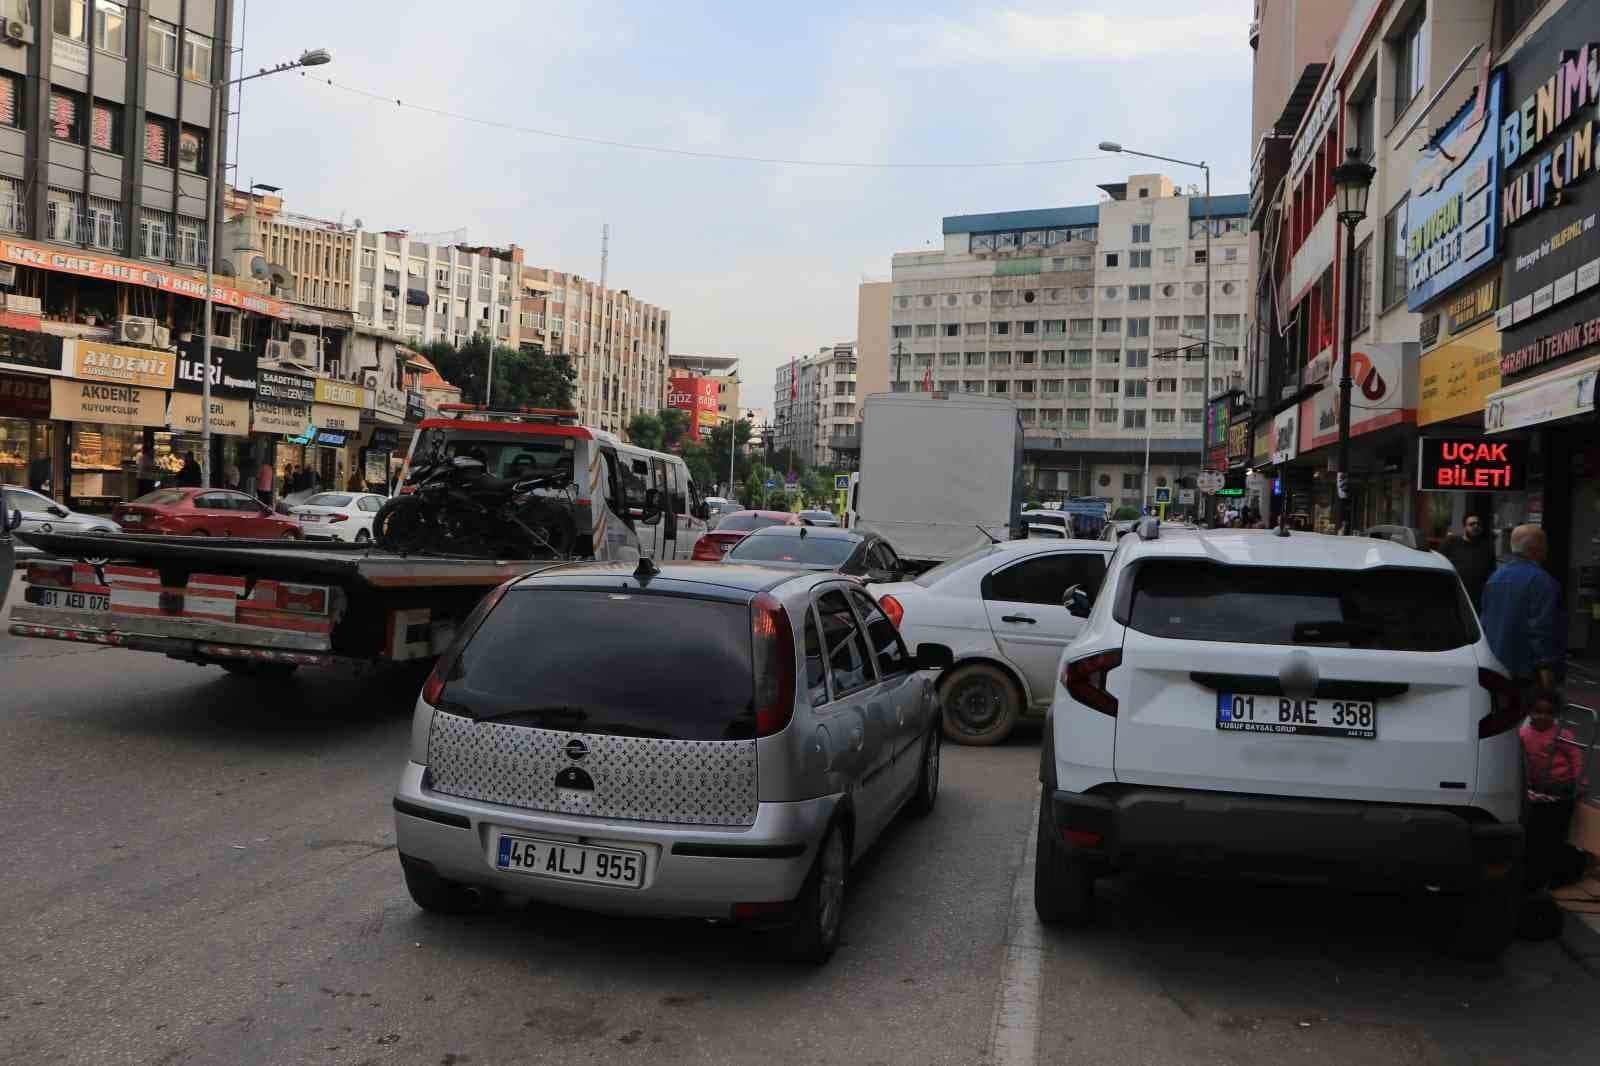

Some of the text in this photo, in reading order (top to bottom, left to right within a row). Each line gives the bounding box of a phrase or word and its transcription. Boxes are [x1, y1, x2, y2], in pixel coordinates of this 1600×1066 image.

[1501, 43, 1588, 168] BENİM
[1424, 192, 1460, 250] UYGUN
[51, 255, 97, 272] CAFE
[83, 350, 168, 376] AKDENİZ
[179, 350, 222, 386] İLERİ
[81, 385, 141, 403] AKDENİZ
[81, 403, 139, 416] KUYUMCULUK
[1442, 442, 1508, 465] UÇAK
[1437, 464, 1511, 487] BİLETİ
[89, 596, 110, 611] 076
[1232, 696, 1255, 721] 01
[1278, 698, 1318, 724] BAE
[1332, 701, 1371, 727] 358
[1219, 721, 1244, 731] YUSUF
[1275, 725, 1297, 733] GRUP
[511, 842, 537, 868] 46
[545, 846, 587, 875] ALJ
[596, 853, 637, 882] 955
